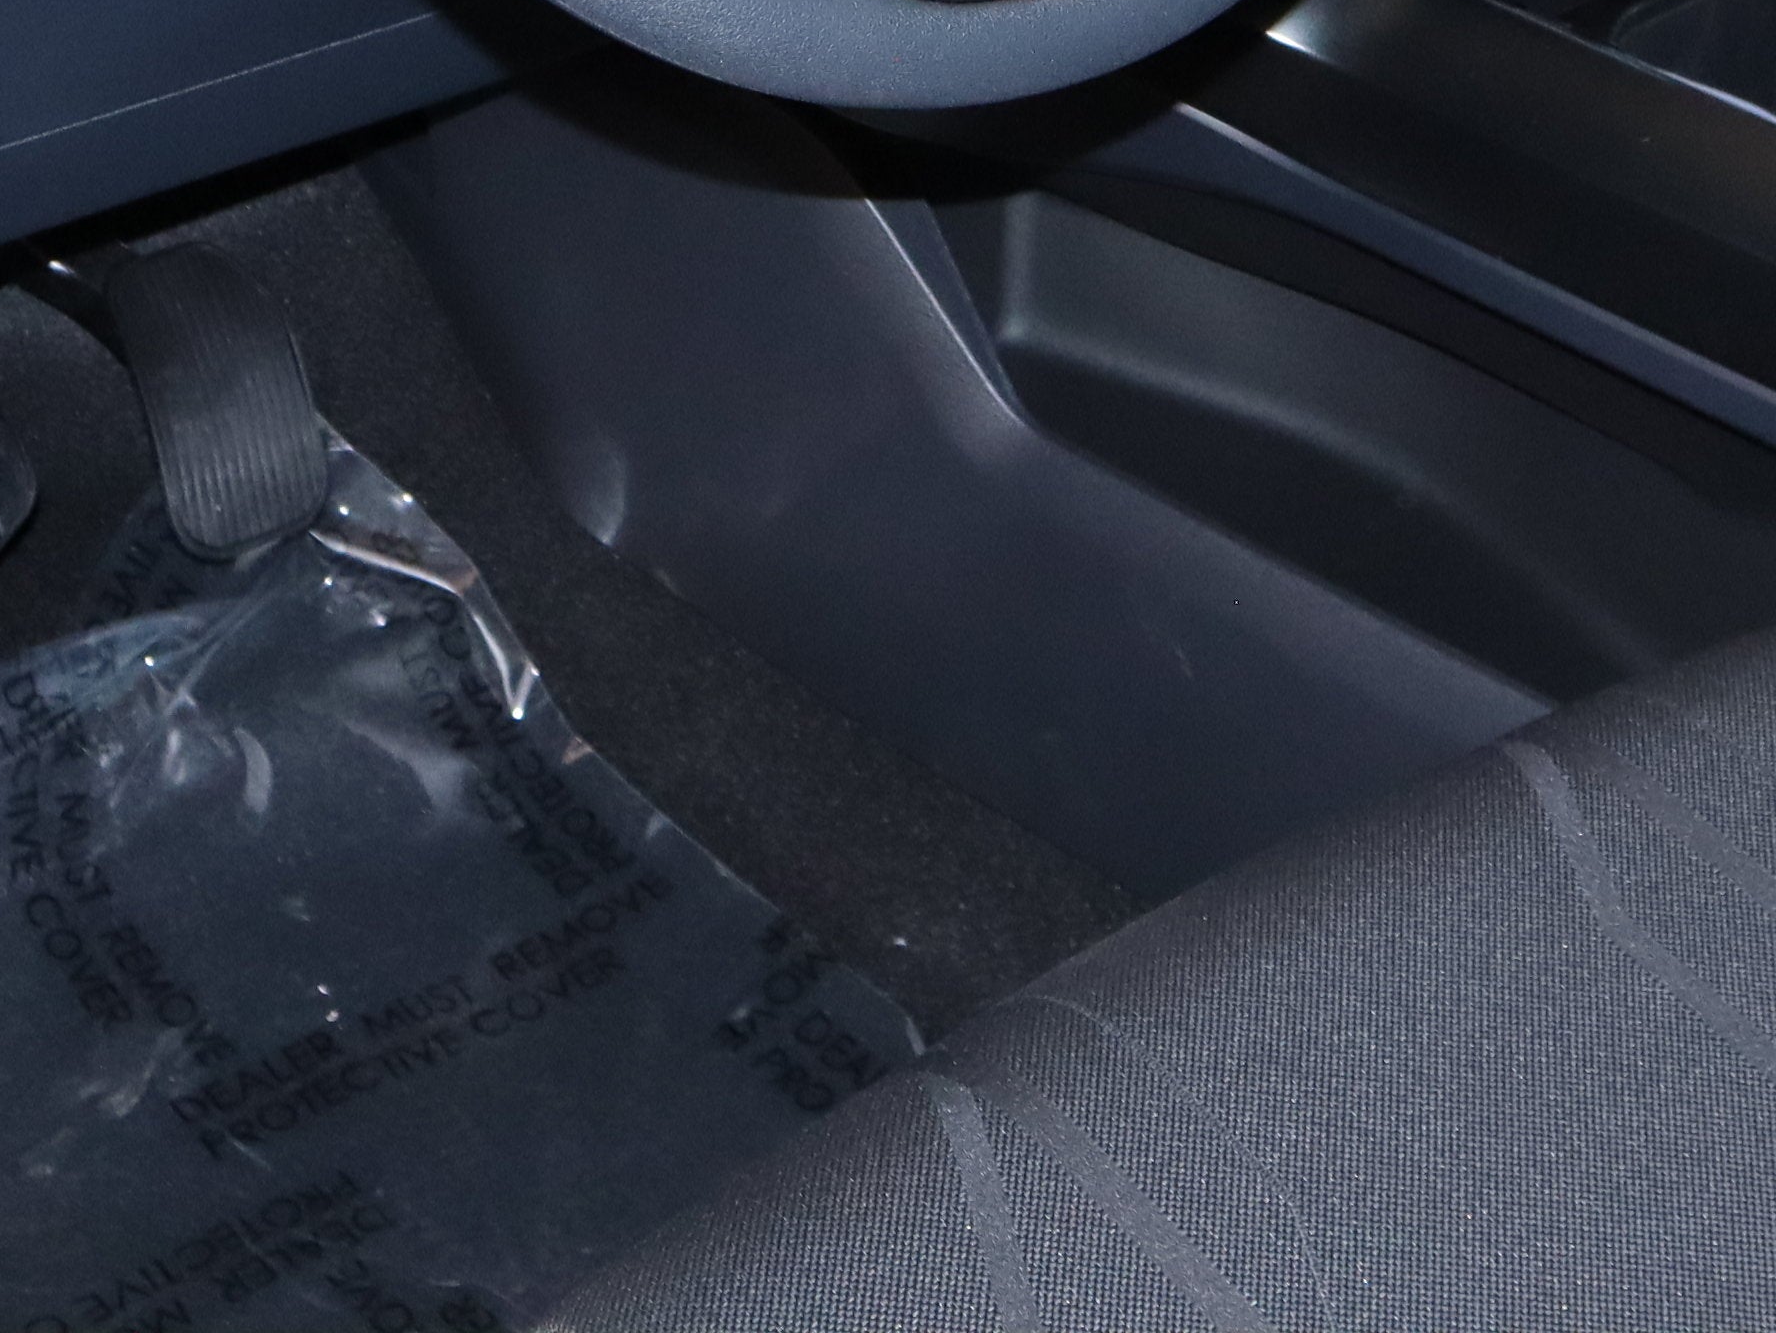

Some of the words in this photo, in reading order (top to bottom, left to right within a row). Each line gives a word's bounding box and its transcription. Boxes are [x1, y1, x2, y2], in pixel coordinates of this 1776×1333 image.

[26, 893, 132, 1031] COVER
[52, 789, 114, 907] MUST
[108, 922, 239, 1069] REMOVE
[170, 1031, 345, 1126] DEALER
[359, 972, 475, 1038] MUST
[487, 873, 674, 981] REMOVE
[198, 1031, 464, 1162] PROTECTIVE
[469, 944, 625, 1036] COVER
[73, 1169, 361, 1328] PROTECTIVE
